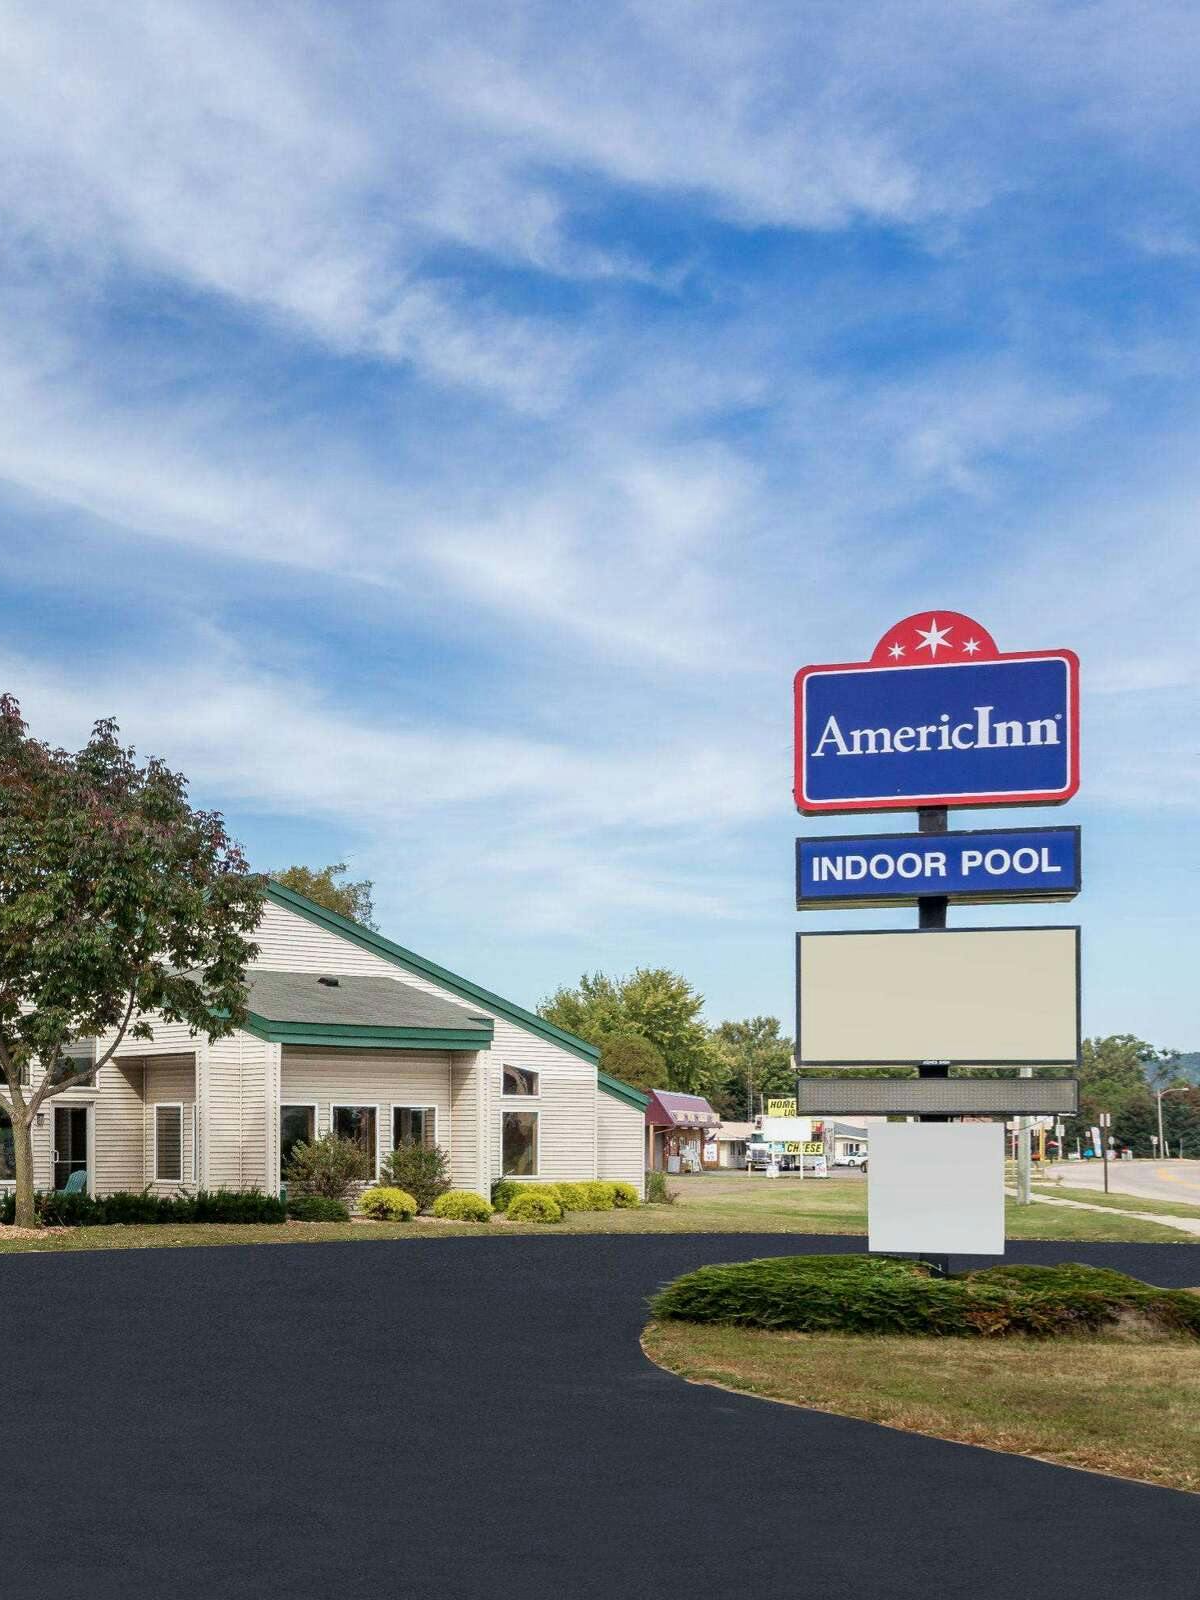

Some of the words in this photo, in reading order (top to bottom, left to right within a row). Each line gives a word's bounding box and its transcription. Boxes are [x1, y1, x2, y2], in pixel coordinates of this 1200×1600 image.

[810, 705, 1060, 757] AmericInn
[812, 851, 947, 882] INDOOR
[961, 847, 1062, 876] POOL
[787, 1143, 822, 1153] CHESE
